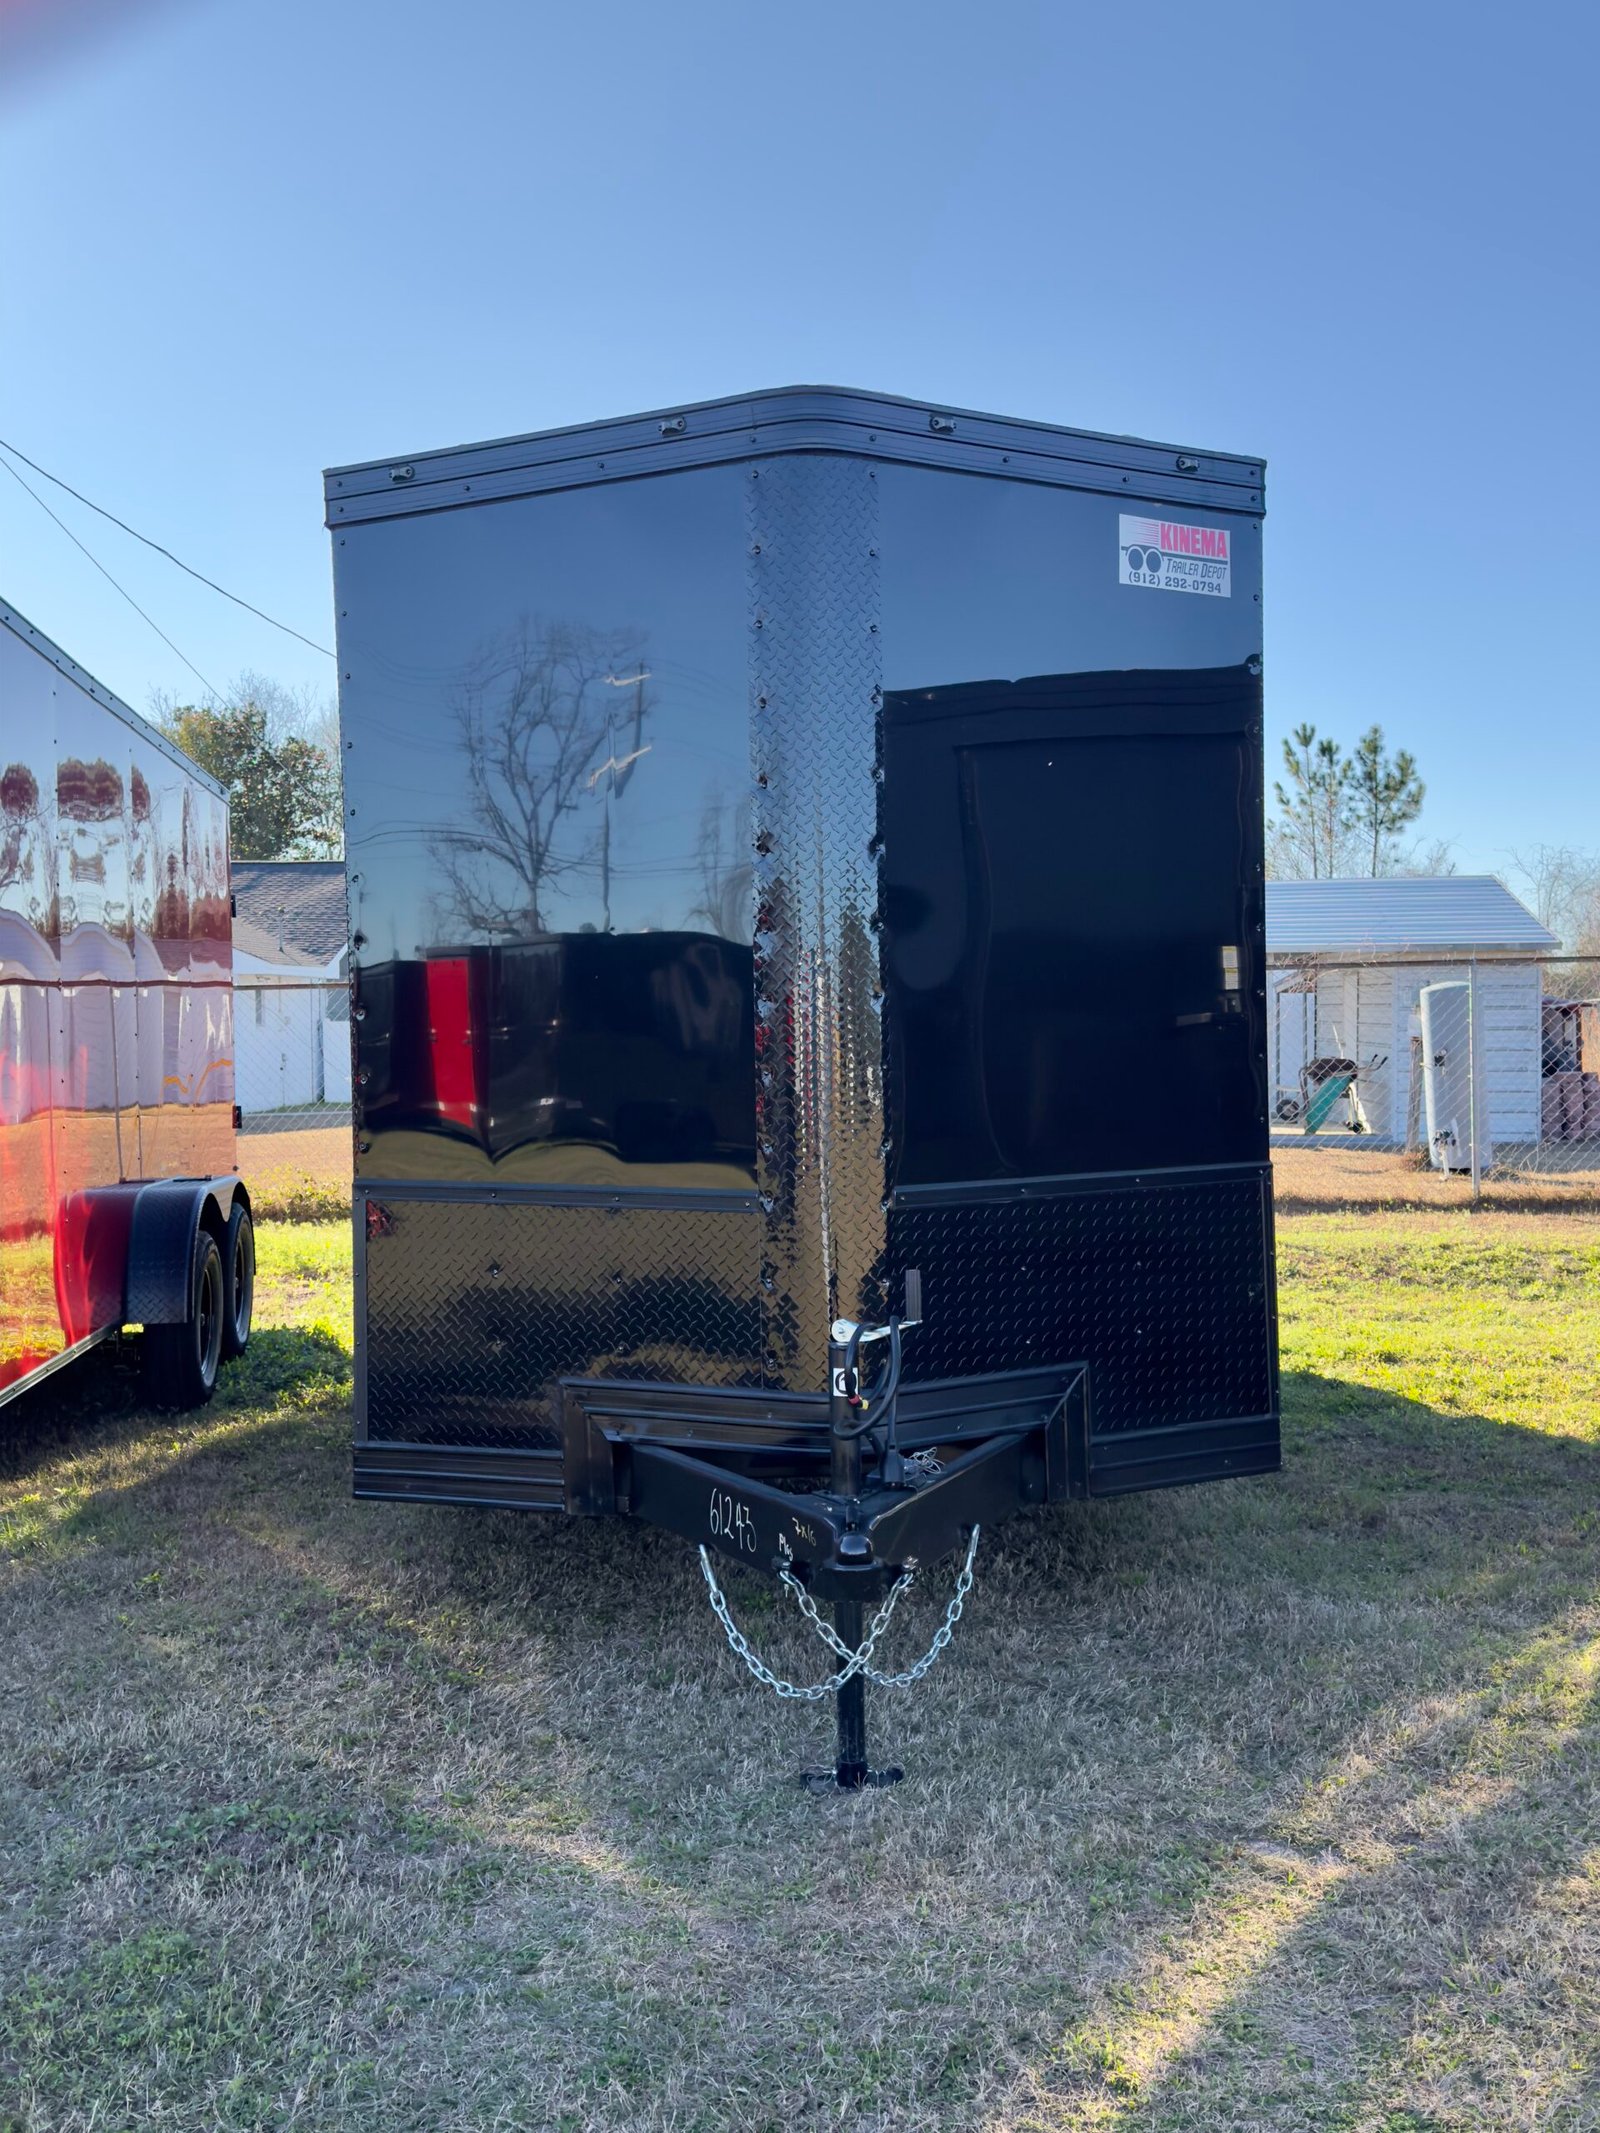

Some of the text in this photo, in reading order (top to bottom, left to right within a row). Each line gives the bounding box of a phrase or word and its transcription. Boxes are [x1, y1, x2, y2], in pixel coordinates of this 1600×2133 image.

[1160, 523, 1227, 558] KINEMA
[1128, 570, 1221, 593] (912) 292-0794
[710, 1488, 757, 1552] 61243
